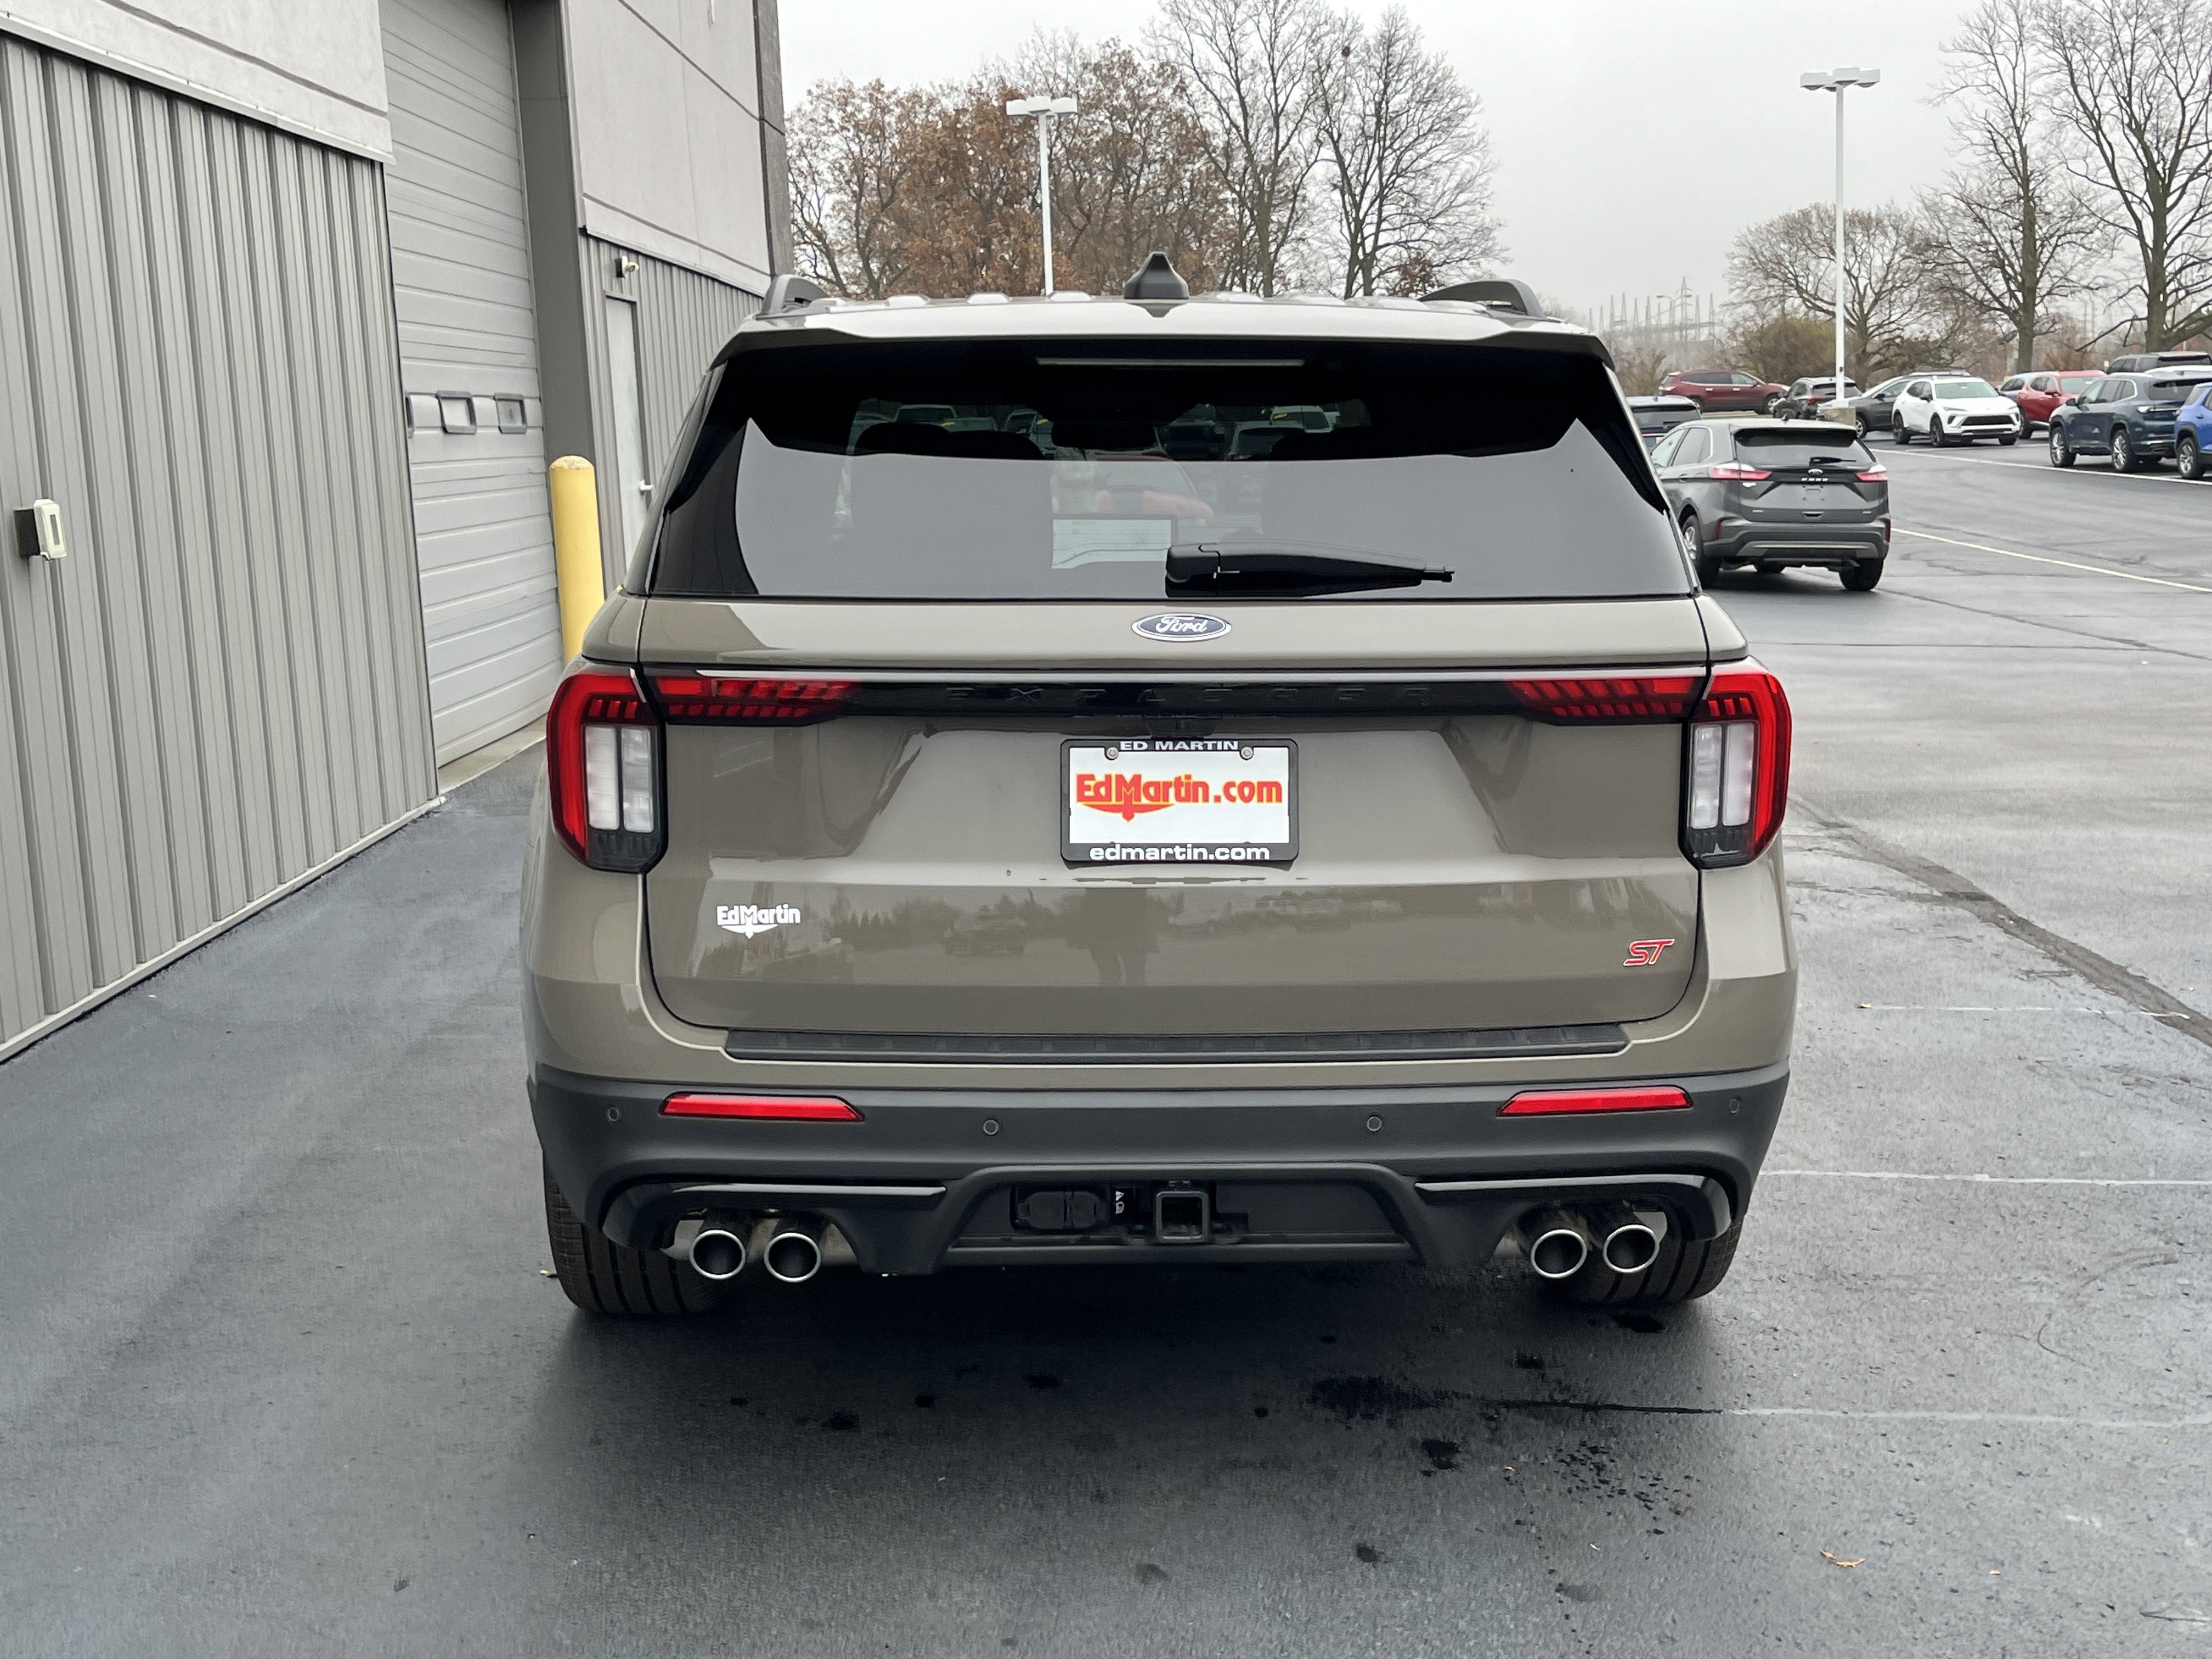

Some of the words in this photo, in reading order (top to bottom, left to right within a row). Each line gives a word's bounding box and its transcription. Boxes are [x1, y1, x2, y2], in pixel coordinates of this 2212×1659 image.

[1155, 616, 1208, 633] Ford
[1120, 741, 1148, 751] ED
[1155, 741, 1239, 751] MARTIN
[1076, 773, 1283, 804] EdMartin.com
[1090, 844, 1270, 861] edmartin.com
[716, 904, 801, 926] EdMartin
[1623, 938, 1675, 966] ST
